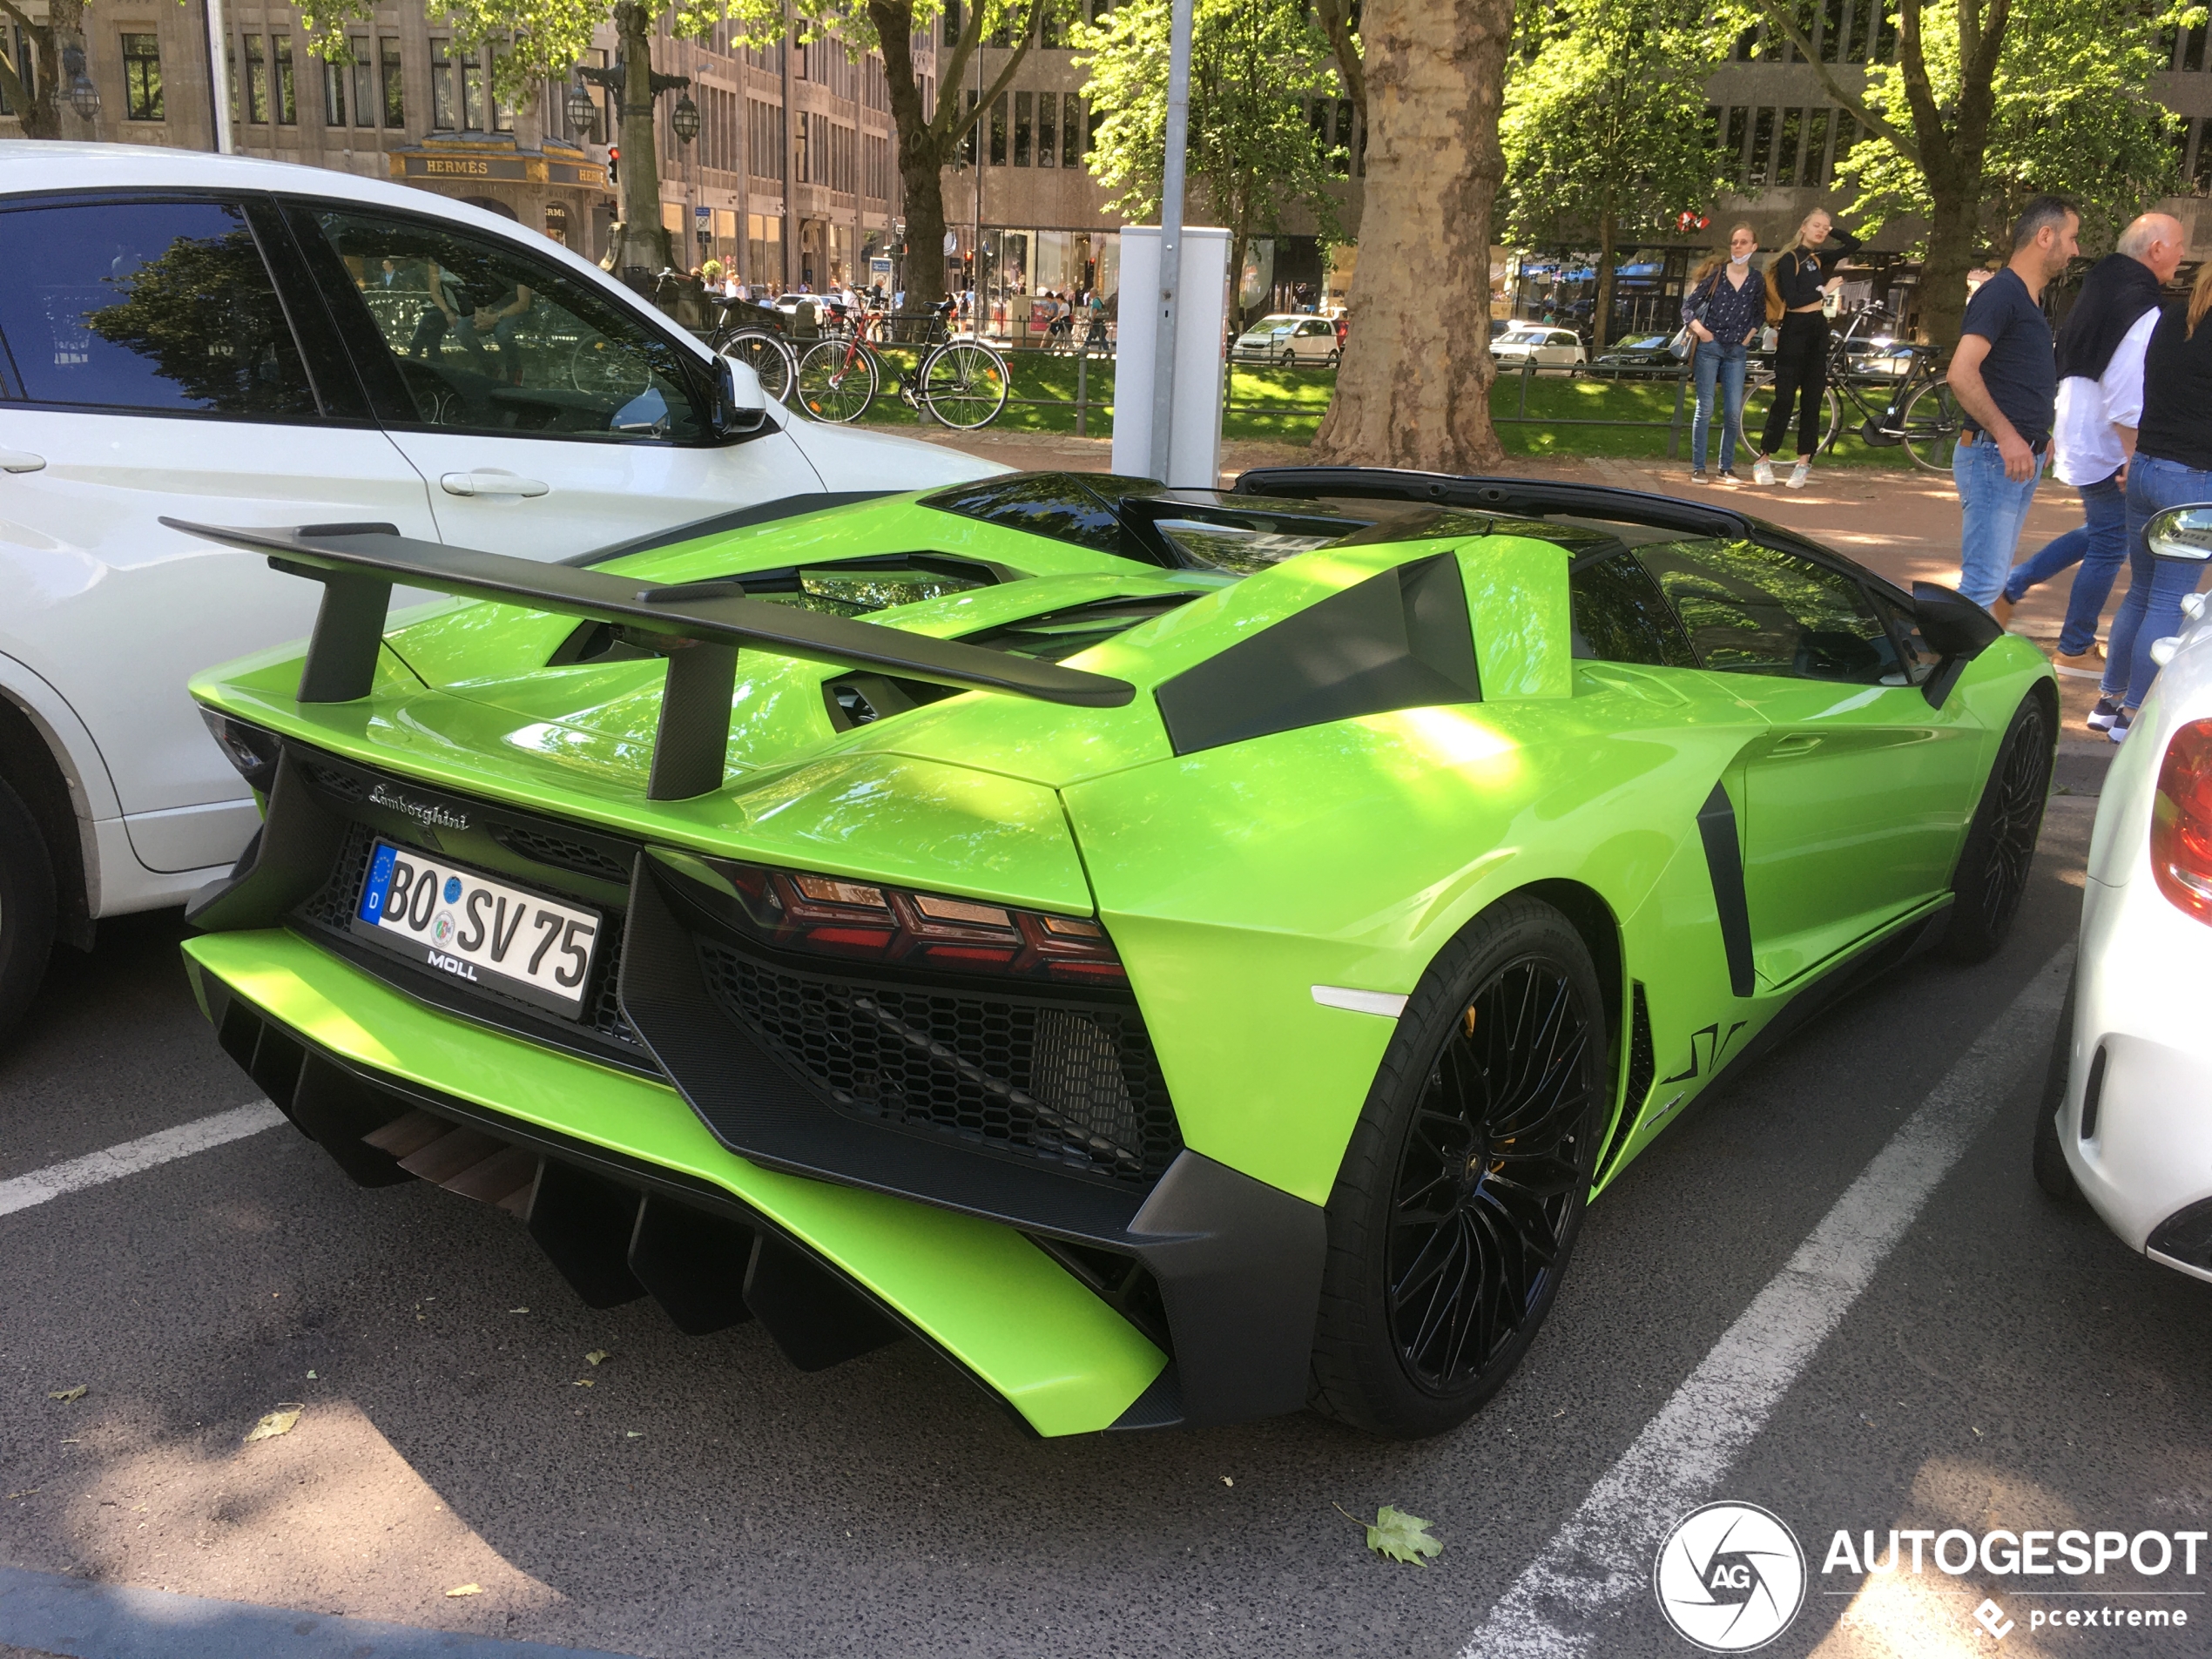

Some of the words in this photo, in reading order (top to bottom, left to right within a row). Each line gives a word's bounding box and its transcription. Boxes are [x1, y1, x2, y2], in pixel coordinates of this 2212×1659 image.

[368, 784, 469, 831] Lamborghini
[368, 892, 379, 909] D
[381, 860, 437, 931] BO
[457, 889, 526, 962] SV
[527, 910, 595, 988] 75
[428, 950, 477, 981] MOLL
